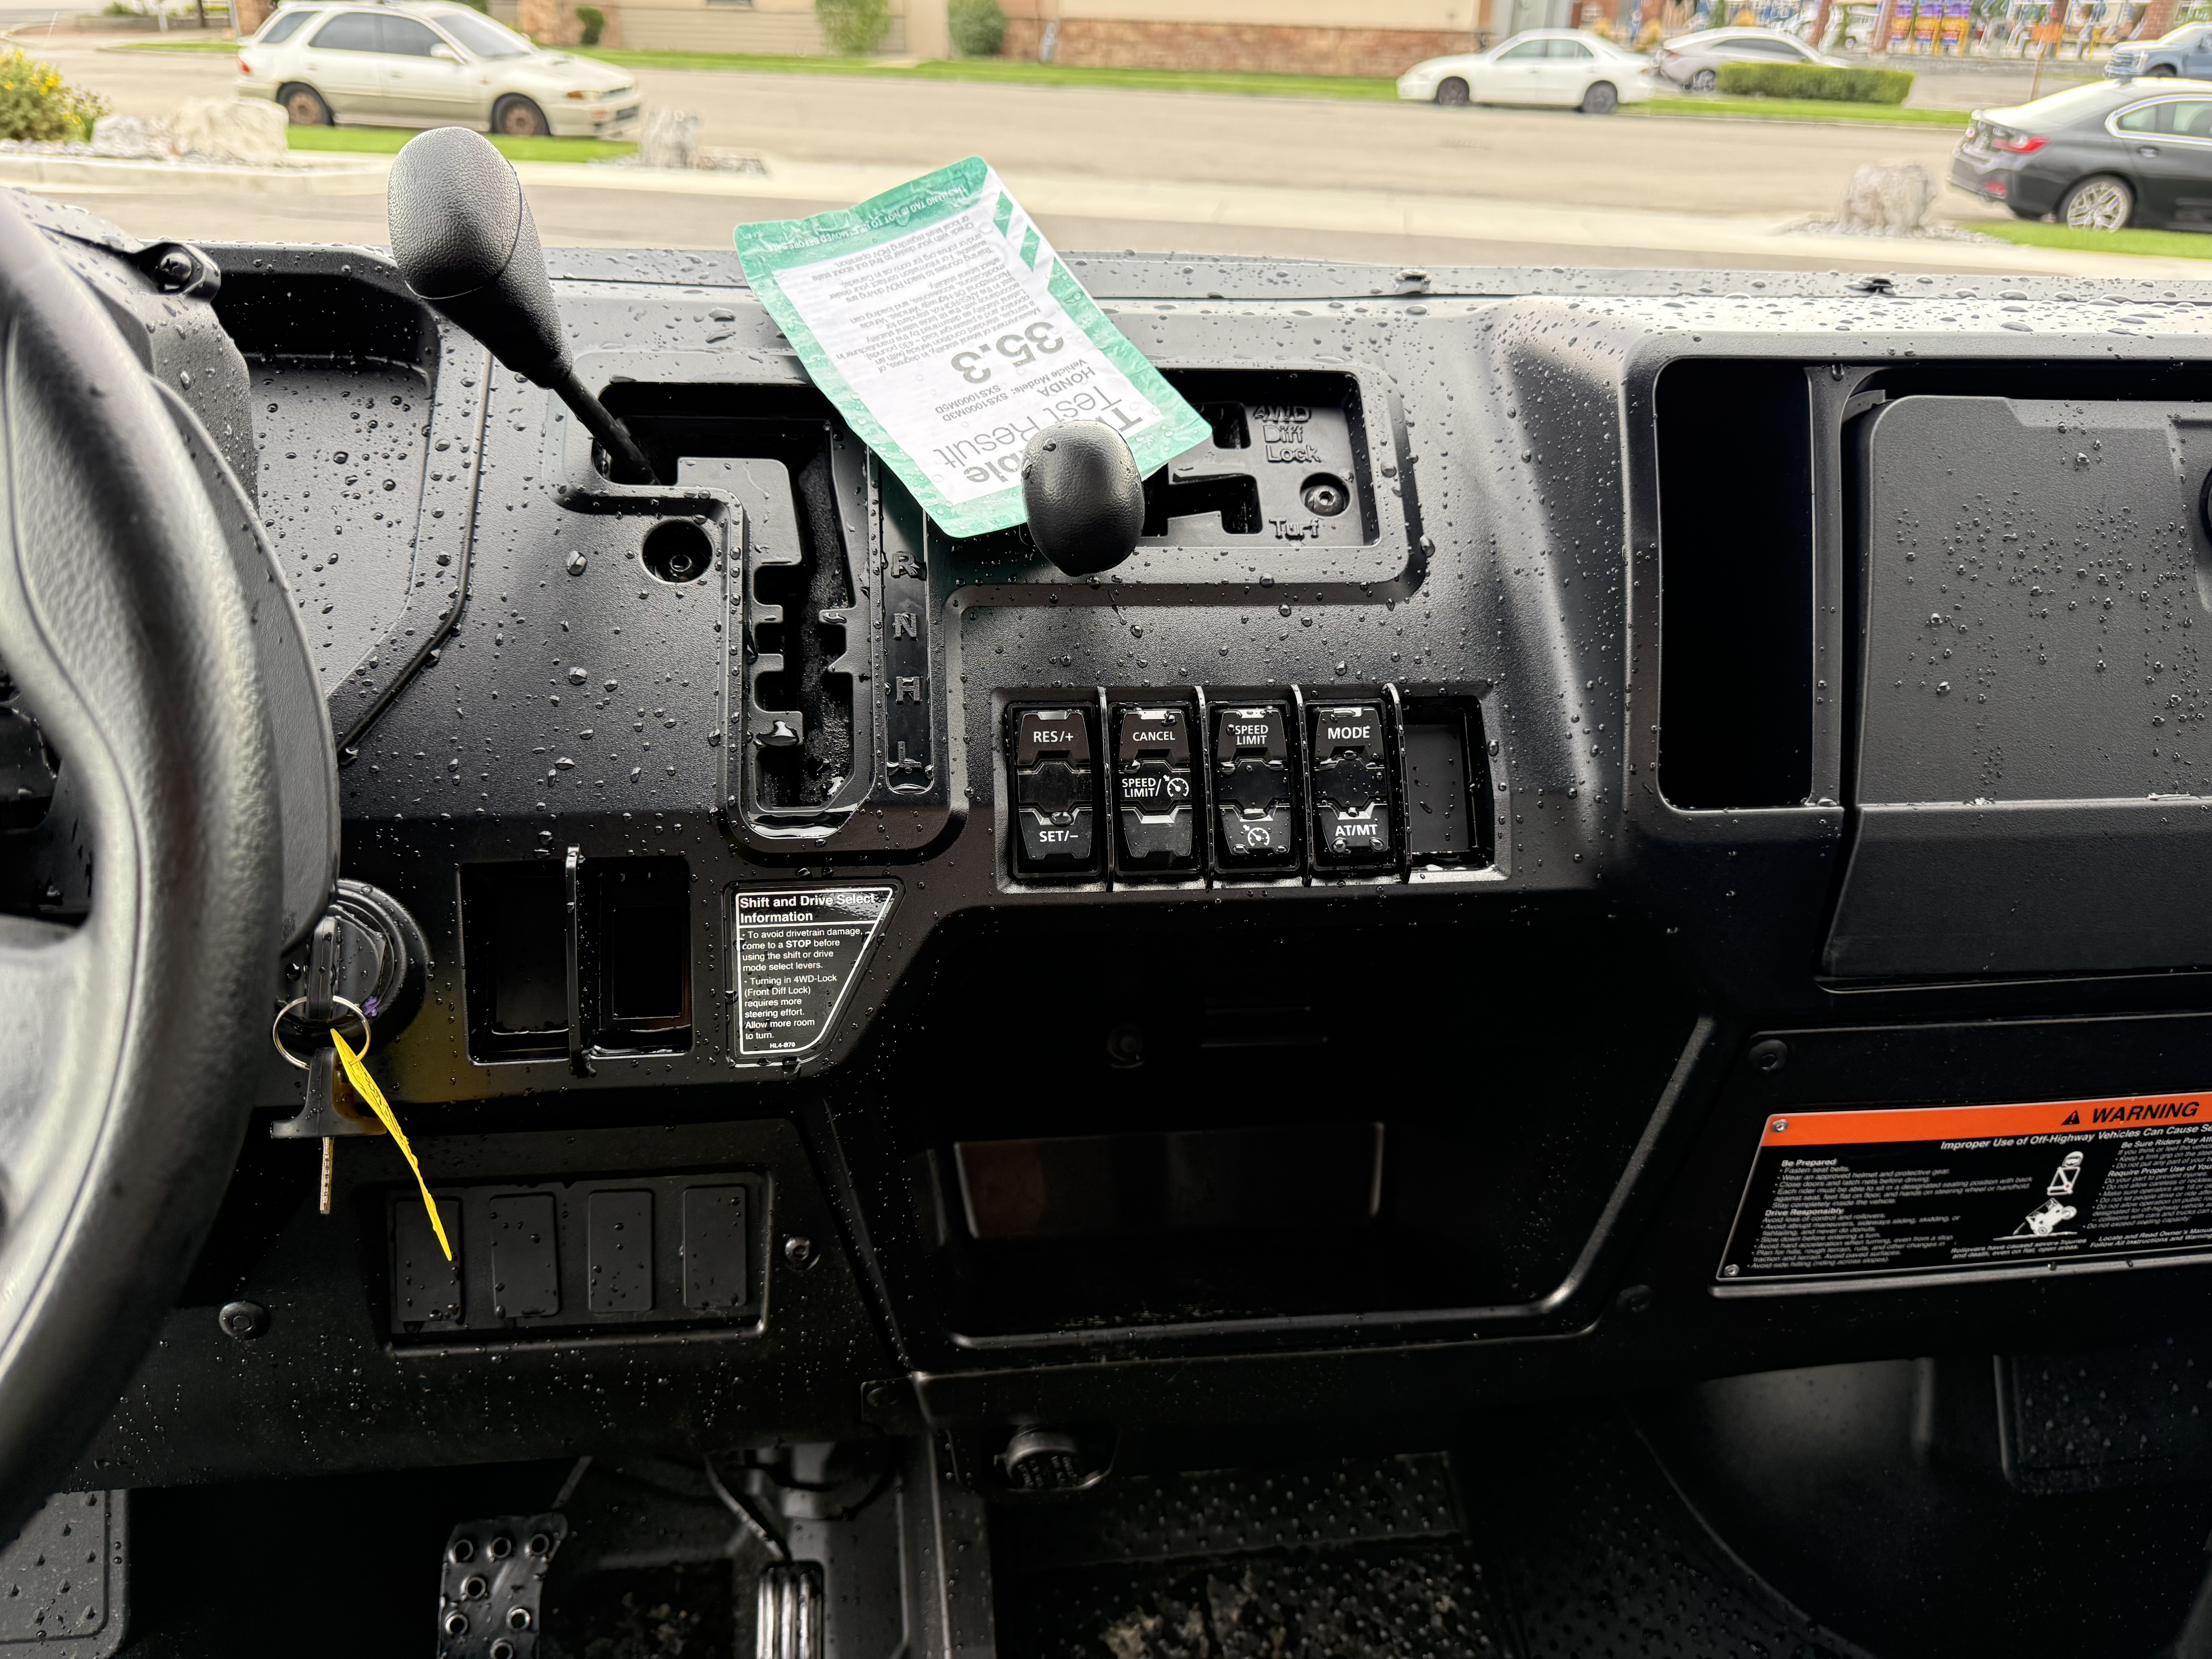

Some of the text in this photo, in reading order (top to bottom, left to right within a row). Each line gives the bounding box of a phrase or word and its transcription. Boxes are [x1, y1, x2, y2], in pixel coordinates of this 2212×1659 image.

[908, 201, 927, 212] TAG
[869, 219, 884, 228] TO
[883, 211, 902, 223] NOT
[785, 238, 821, 249] BEFORE
[979, 258, 1000, 270] affect
[957, 266, 980, 279] lateral
[965, 270, 1011, 293] Recreational
[1000, 276, 1015, 286] test
[919, 289, 967, 309] Off-Highway
[977, 282, 1020, 303] accordance
[1000, 289, 1026, 304] Lateral
[893, 301, 910, 310] and
[961, 301, 977, 311] with
[970, 300, 1000, 314] stability
[999, 295, 1030, 311] operator
[864, 306, 895, 318] loading
[896, 310, 930, 326] standard
[983, 309, 998, 319] and
[859, 317, 888, 328] Vehicle
[918, 316, 938, 325] table
[919, 315, 963, 334] determined
[938, 316, 977, 335] passenger
[967, 317, 1000, 333] standard
[991, 307, 1041, 332] Measurement
[895, 323, 919, 335] lateral
[864, 330, 895, 343] stability
[920, 332, 939, 342] load
[932, 330, 967, 345] condition
[959, 332, 984, 344] lateral
[844, 338, 895, 357] manufacturer
[898, 340, 915, 349] 430
[905, 342, 932, 354] vehicle
[951, 322, 1064, 384] 35.3
[1037, 367, 1095, 396] HONDA
[942, 359, 1087, 422] Vehicle Models: SXS1000M3D
[935, 385, 1000, 414] SXS1000M5D
[1042, 386, 1122, 423] Test
[1263, 426, 1304, 443] Diff
[933, 416, 1040, 467] Result
[1266, 445, 1320, 463] Lock
[1269, 518, 1321, 539] Turf
[891, 552, 917, 578] R
[894, 613, 917, 640] N
[896, 676, 922, 704] H
[1235, 725, 1268, 734] SPEED
[1328, 726, 1370, 739] MODE
[1034, 731, 1073, 742] RES/+
[1133, 732, 1175, 741] CANCEL
[1237, 735, 1267, 745] LIMIT
[897, 742, 922, 769] L
[1122, 778, 1156, 787] SPEED
[1335, 824, 1377, 836] AT/MT
[740, 893, 876, 908] Shift and Drive Select
[741, 912, 812, 923] Information
[743, 953, 765, 962] using
[749, 977, 781, 986] Turning
[793, 974, 837, 982] 4WD-Lock
[745, 989, 769, 998] (Front
[788, 986, 811, 994] Lock)
[745, 999, 778, 1008] requires
[745, 1010, 778, 1018] steering
[2093, 1102, 2199, 1122] WARNING
[1941, 1140, 1990, 1151] Improper
[1992, 1138, 2014, 1146] Use
[2030, 1133, 2094, 1144] Off-Highway
[2098, 1130, 2140, 1139] Vehicles
[1795, 1158, 1839, 1166] Prepared
[1789, 1207, 1844, 1216] Responsibly
